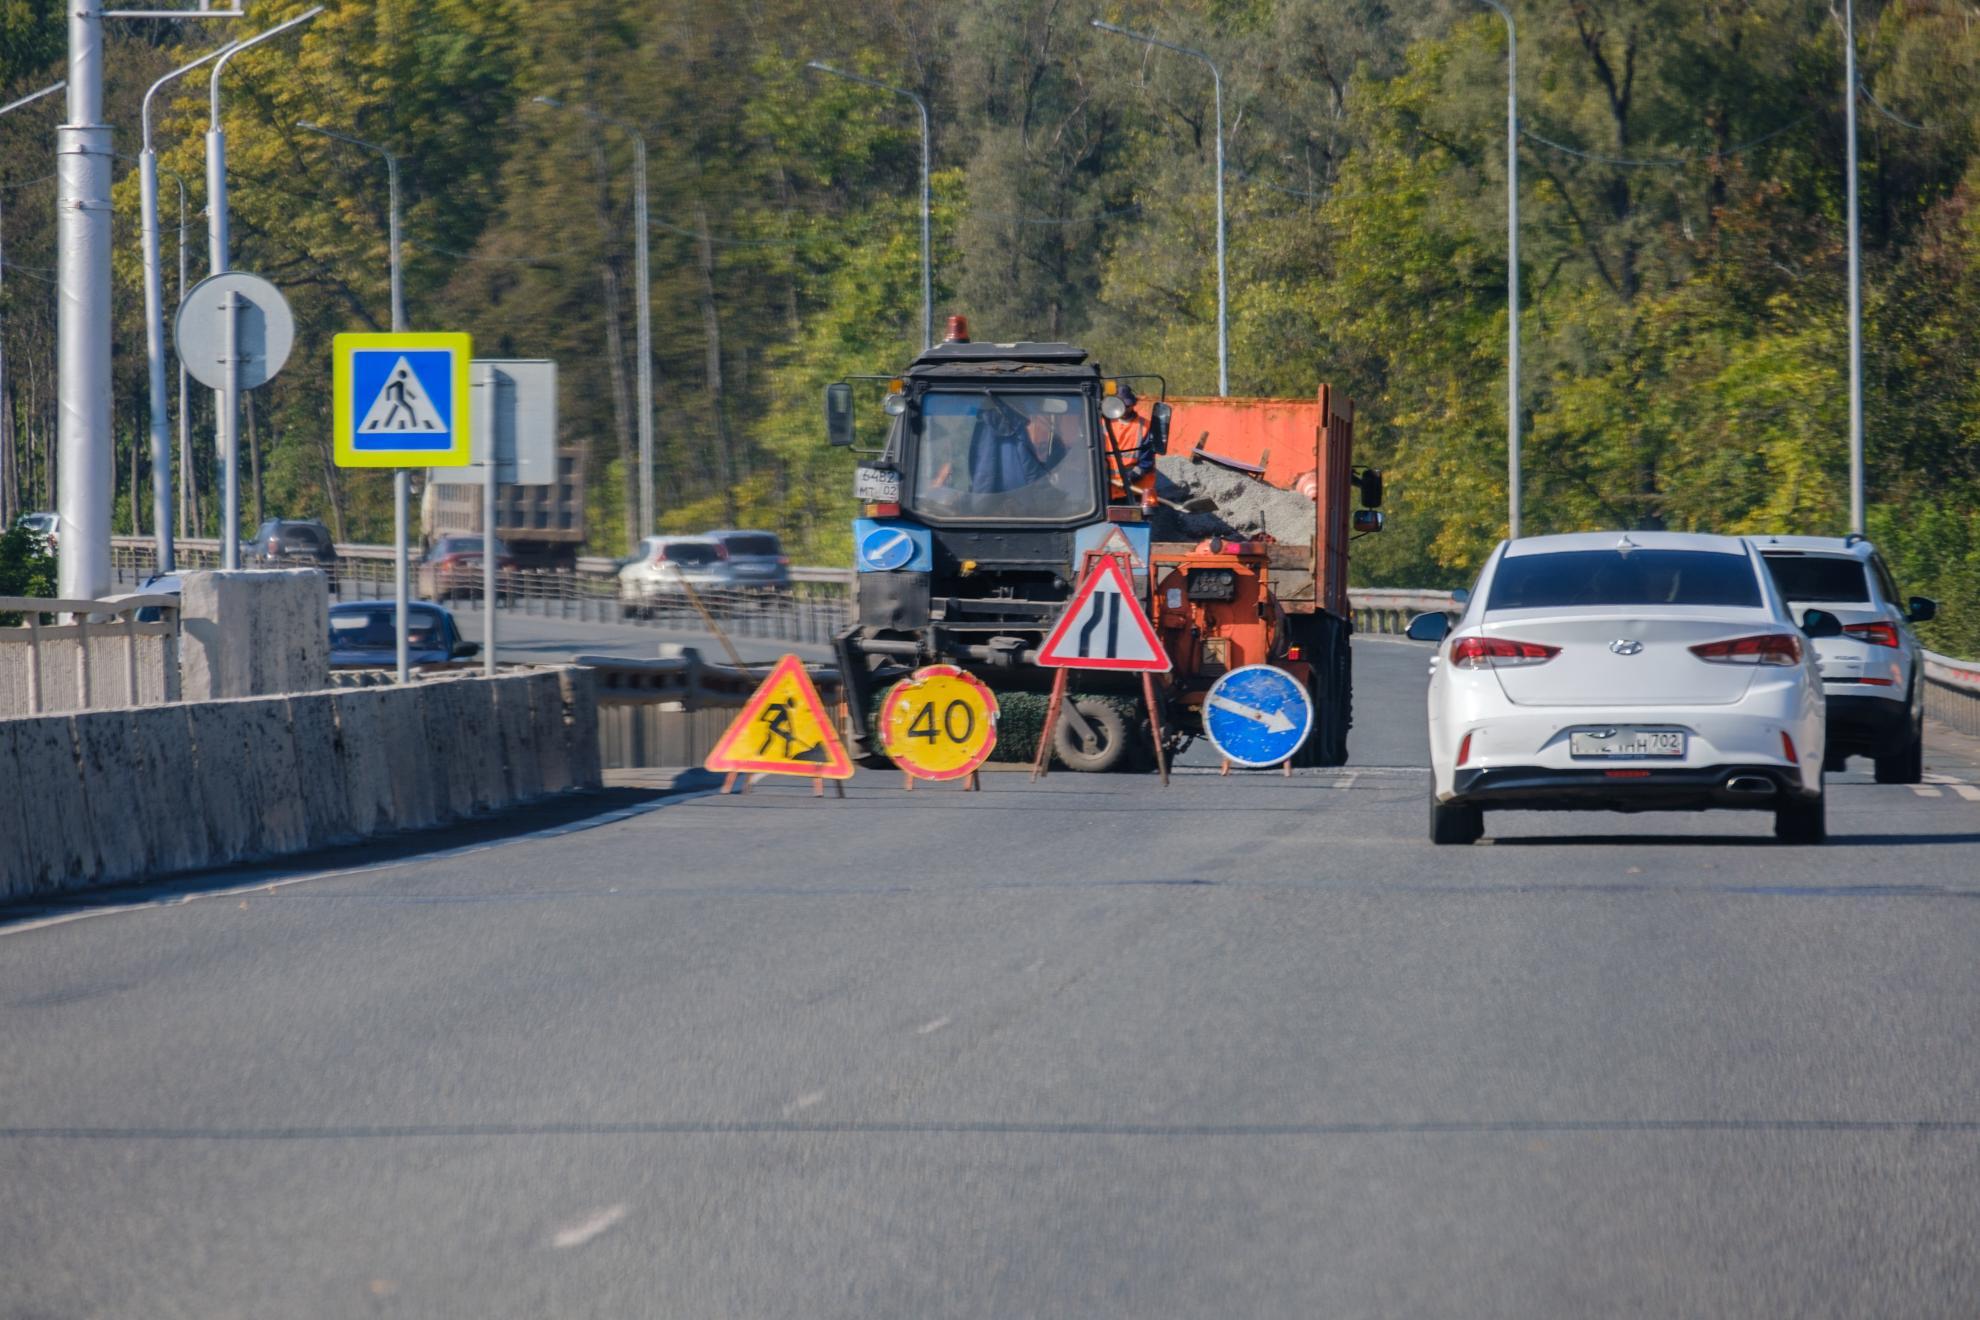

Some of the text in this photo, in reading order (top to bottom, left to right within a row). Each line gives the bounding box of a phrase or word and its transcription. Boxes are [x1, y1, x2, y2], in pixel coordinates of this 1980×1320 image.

[883, 485, 898, 496] 02
[907, 699, 975, 745] 40
[1650, 734, 1679, 748] 702
